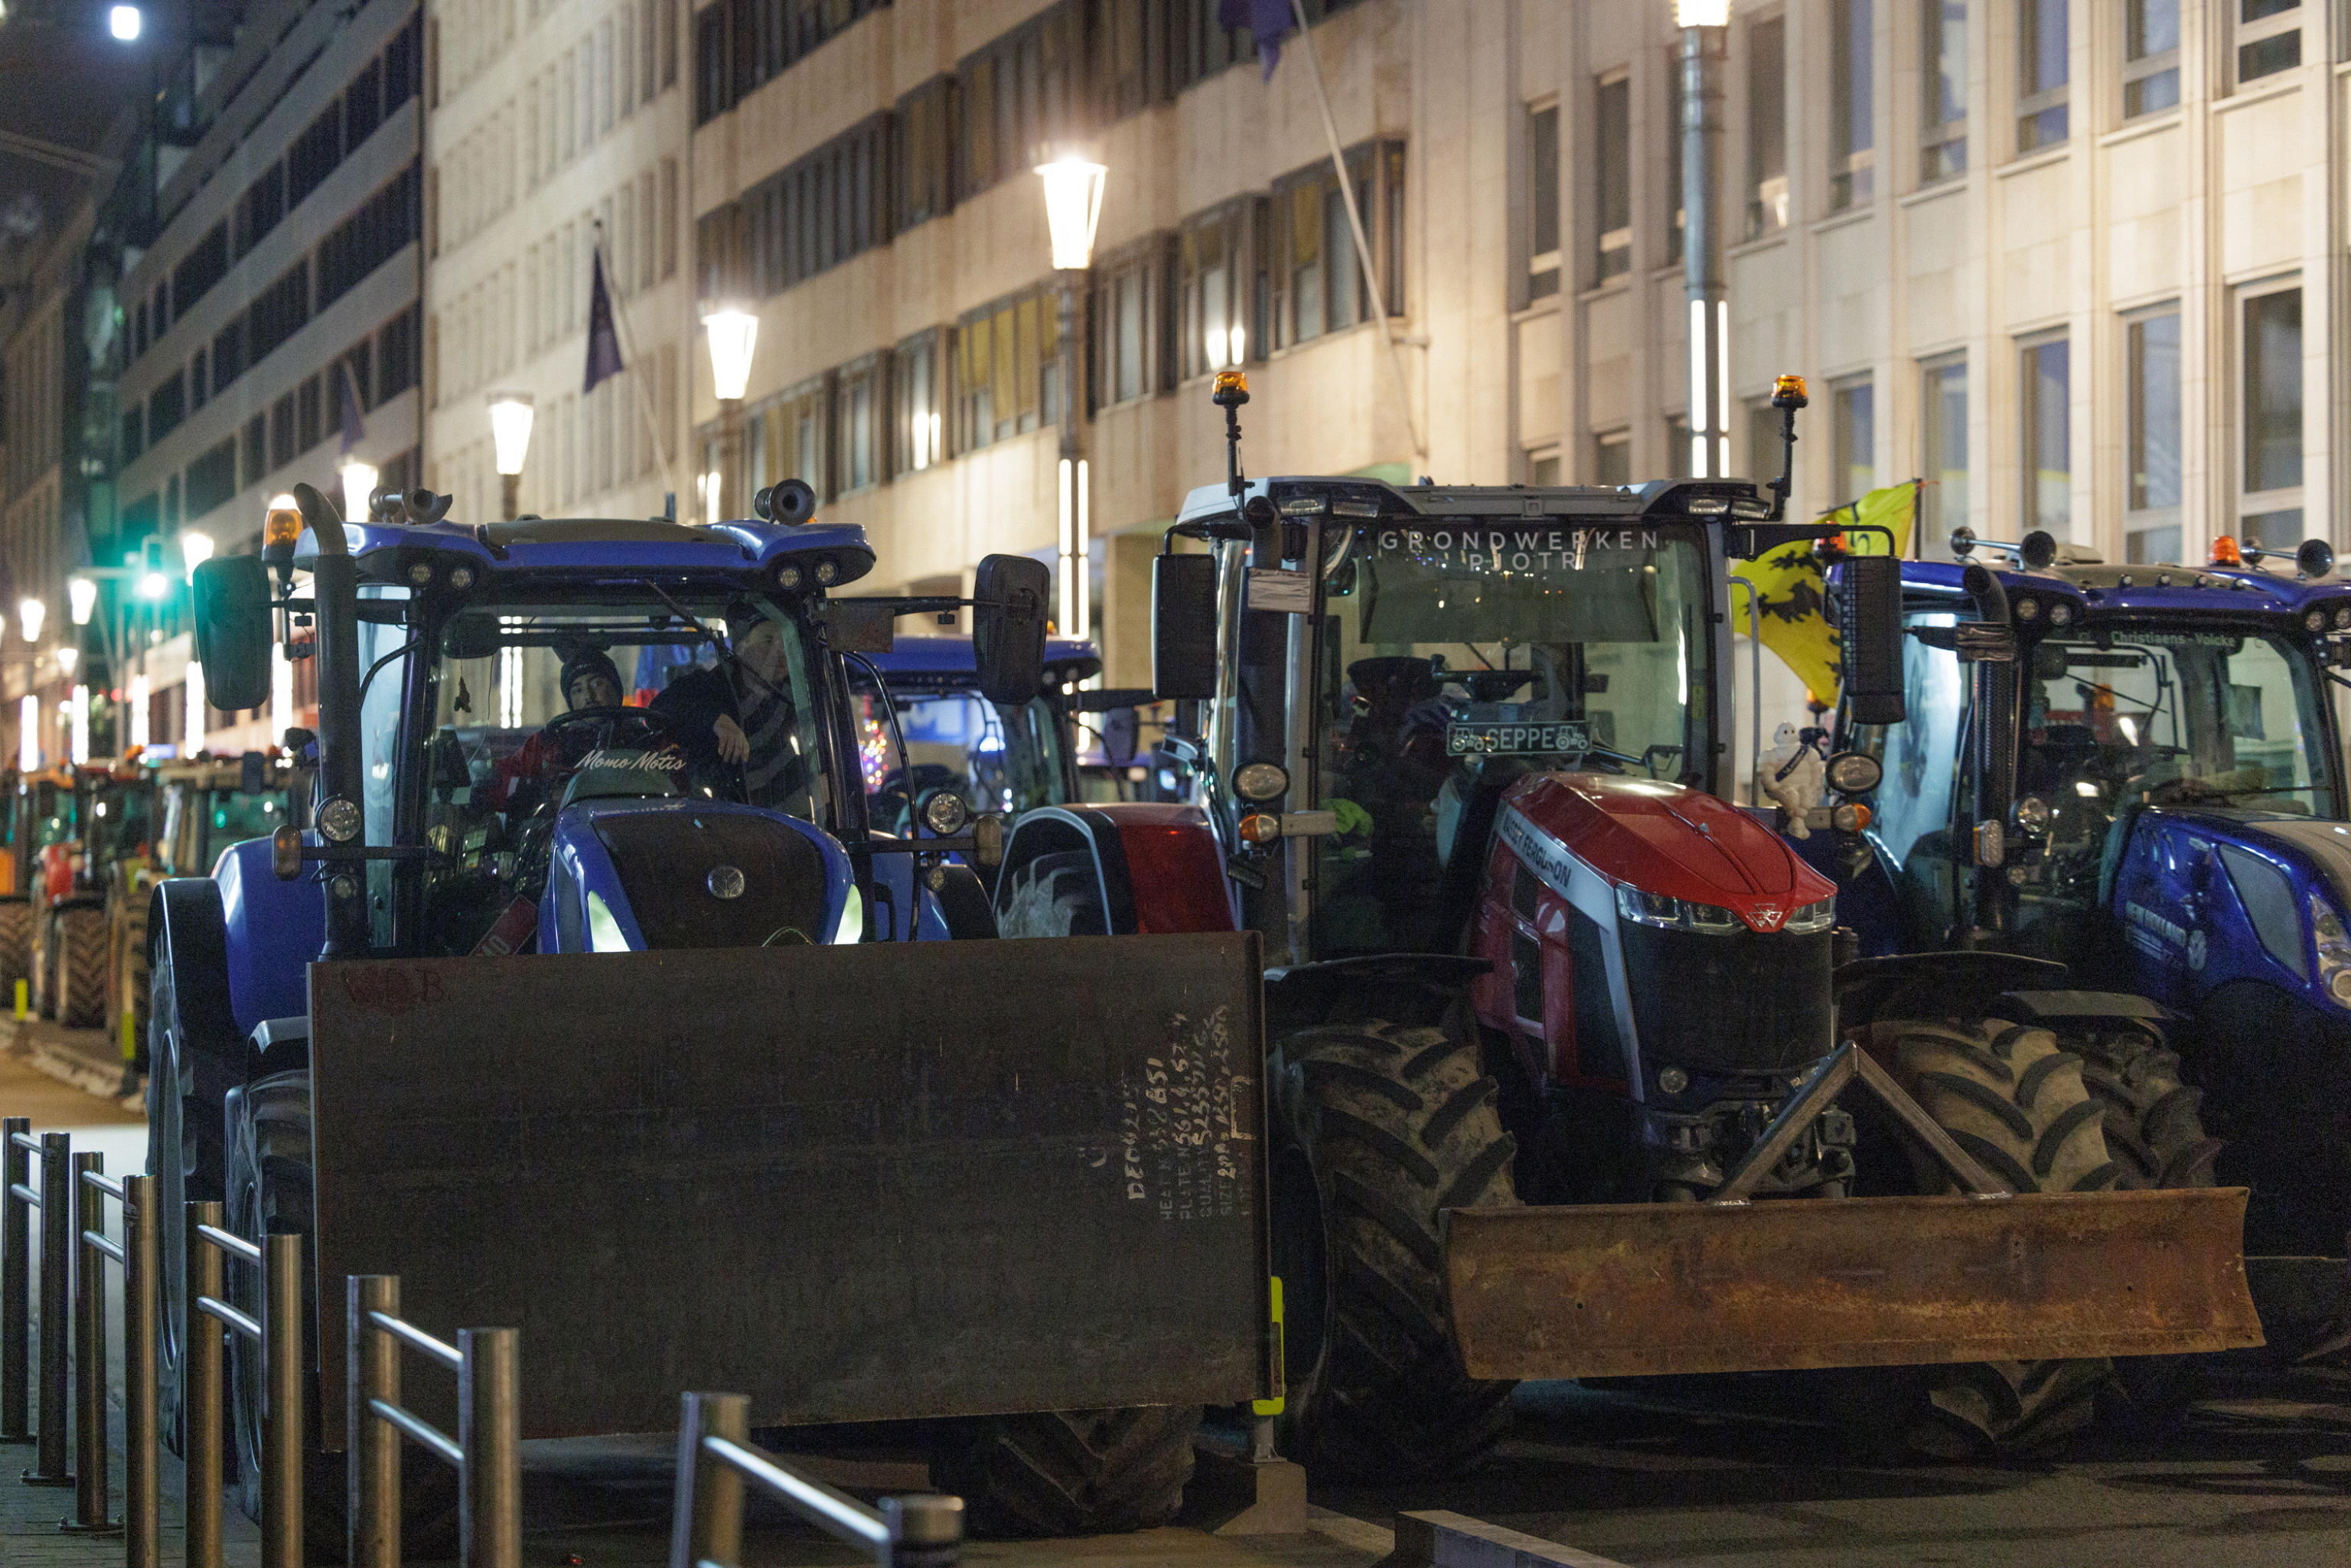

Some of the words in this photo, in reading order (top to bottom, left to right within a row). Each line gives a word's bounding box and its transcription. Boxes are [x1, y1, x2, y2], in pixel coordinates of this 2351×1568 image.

[1381, 530, 1657, 550] GRONDWERKEN
[1486, 728, 1554, 749] SEPPE
[574, 749, 630, 770] Momo
